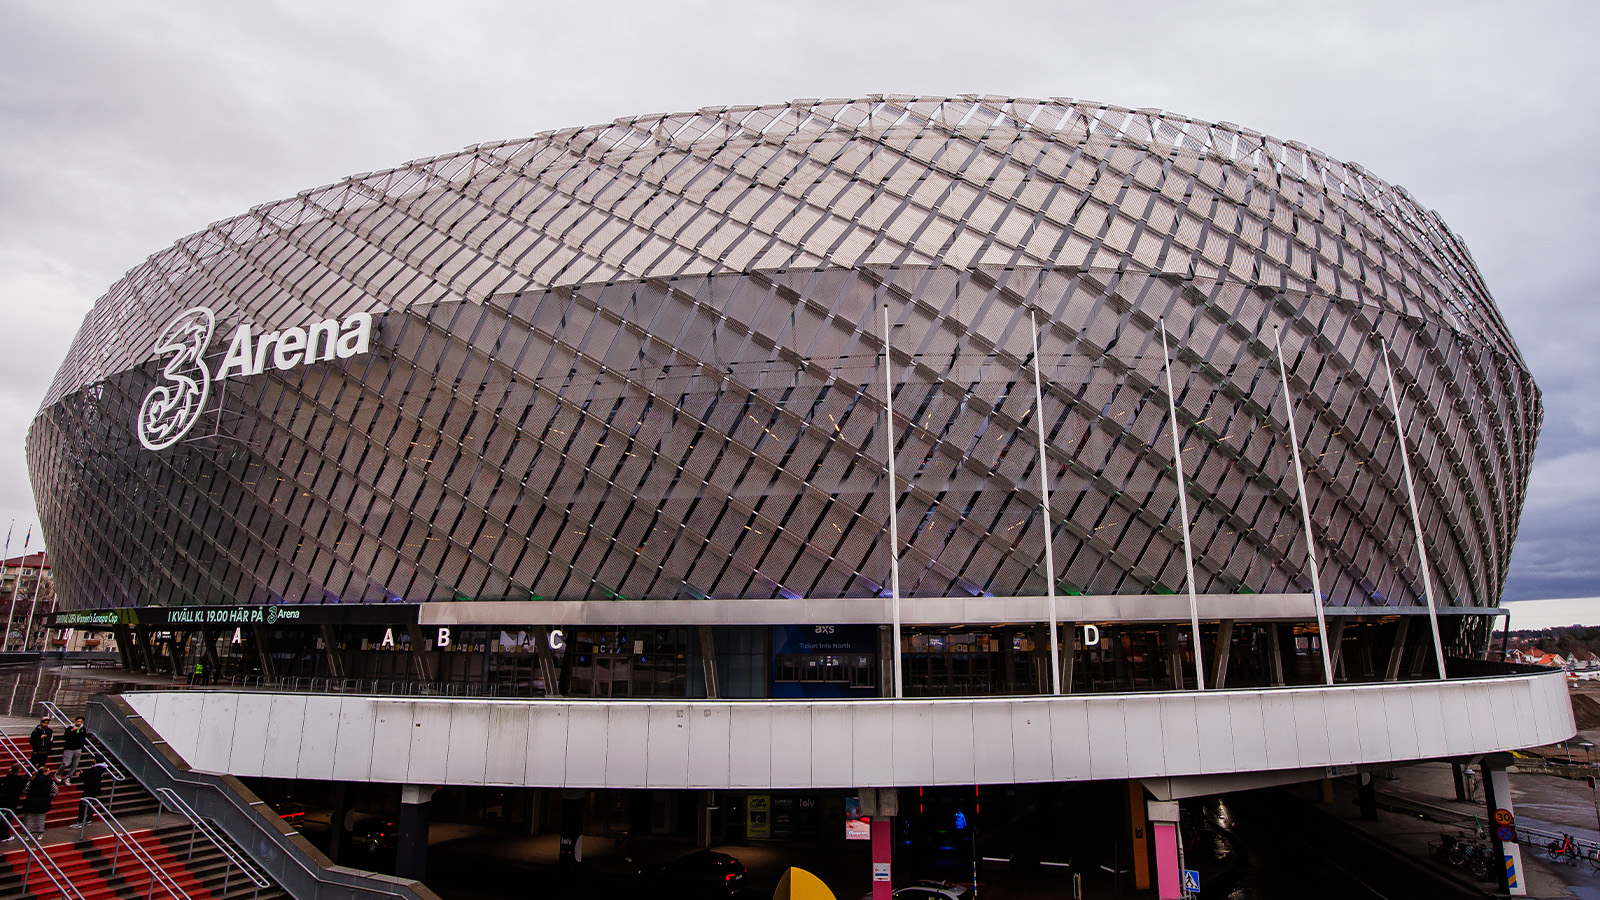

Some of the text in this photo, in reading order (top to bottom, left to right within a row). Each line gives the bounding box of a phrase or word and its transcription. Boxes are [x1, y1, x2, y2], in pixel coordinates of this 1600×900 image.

[215, 311, 372, 381] Arena
[108, 612, 118, 624] Cup
[168, 606, 264, 622] I KVÄLL KL 19.00 HÄR PÅ
[278, 608, 300, 619] Arena
[232, 627, 242, 644] A
[382, 628, 394, 646] A
[438, 628, 450, 647] B
[814, 625, 835, 634] axs
[1084, 625, 1099, 646] D
[549, 629, 564, 650] C
[600, 644, 606, 653] C
[1496, 813, 1510, 822] 30
